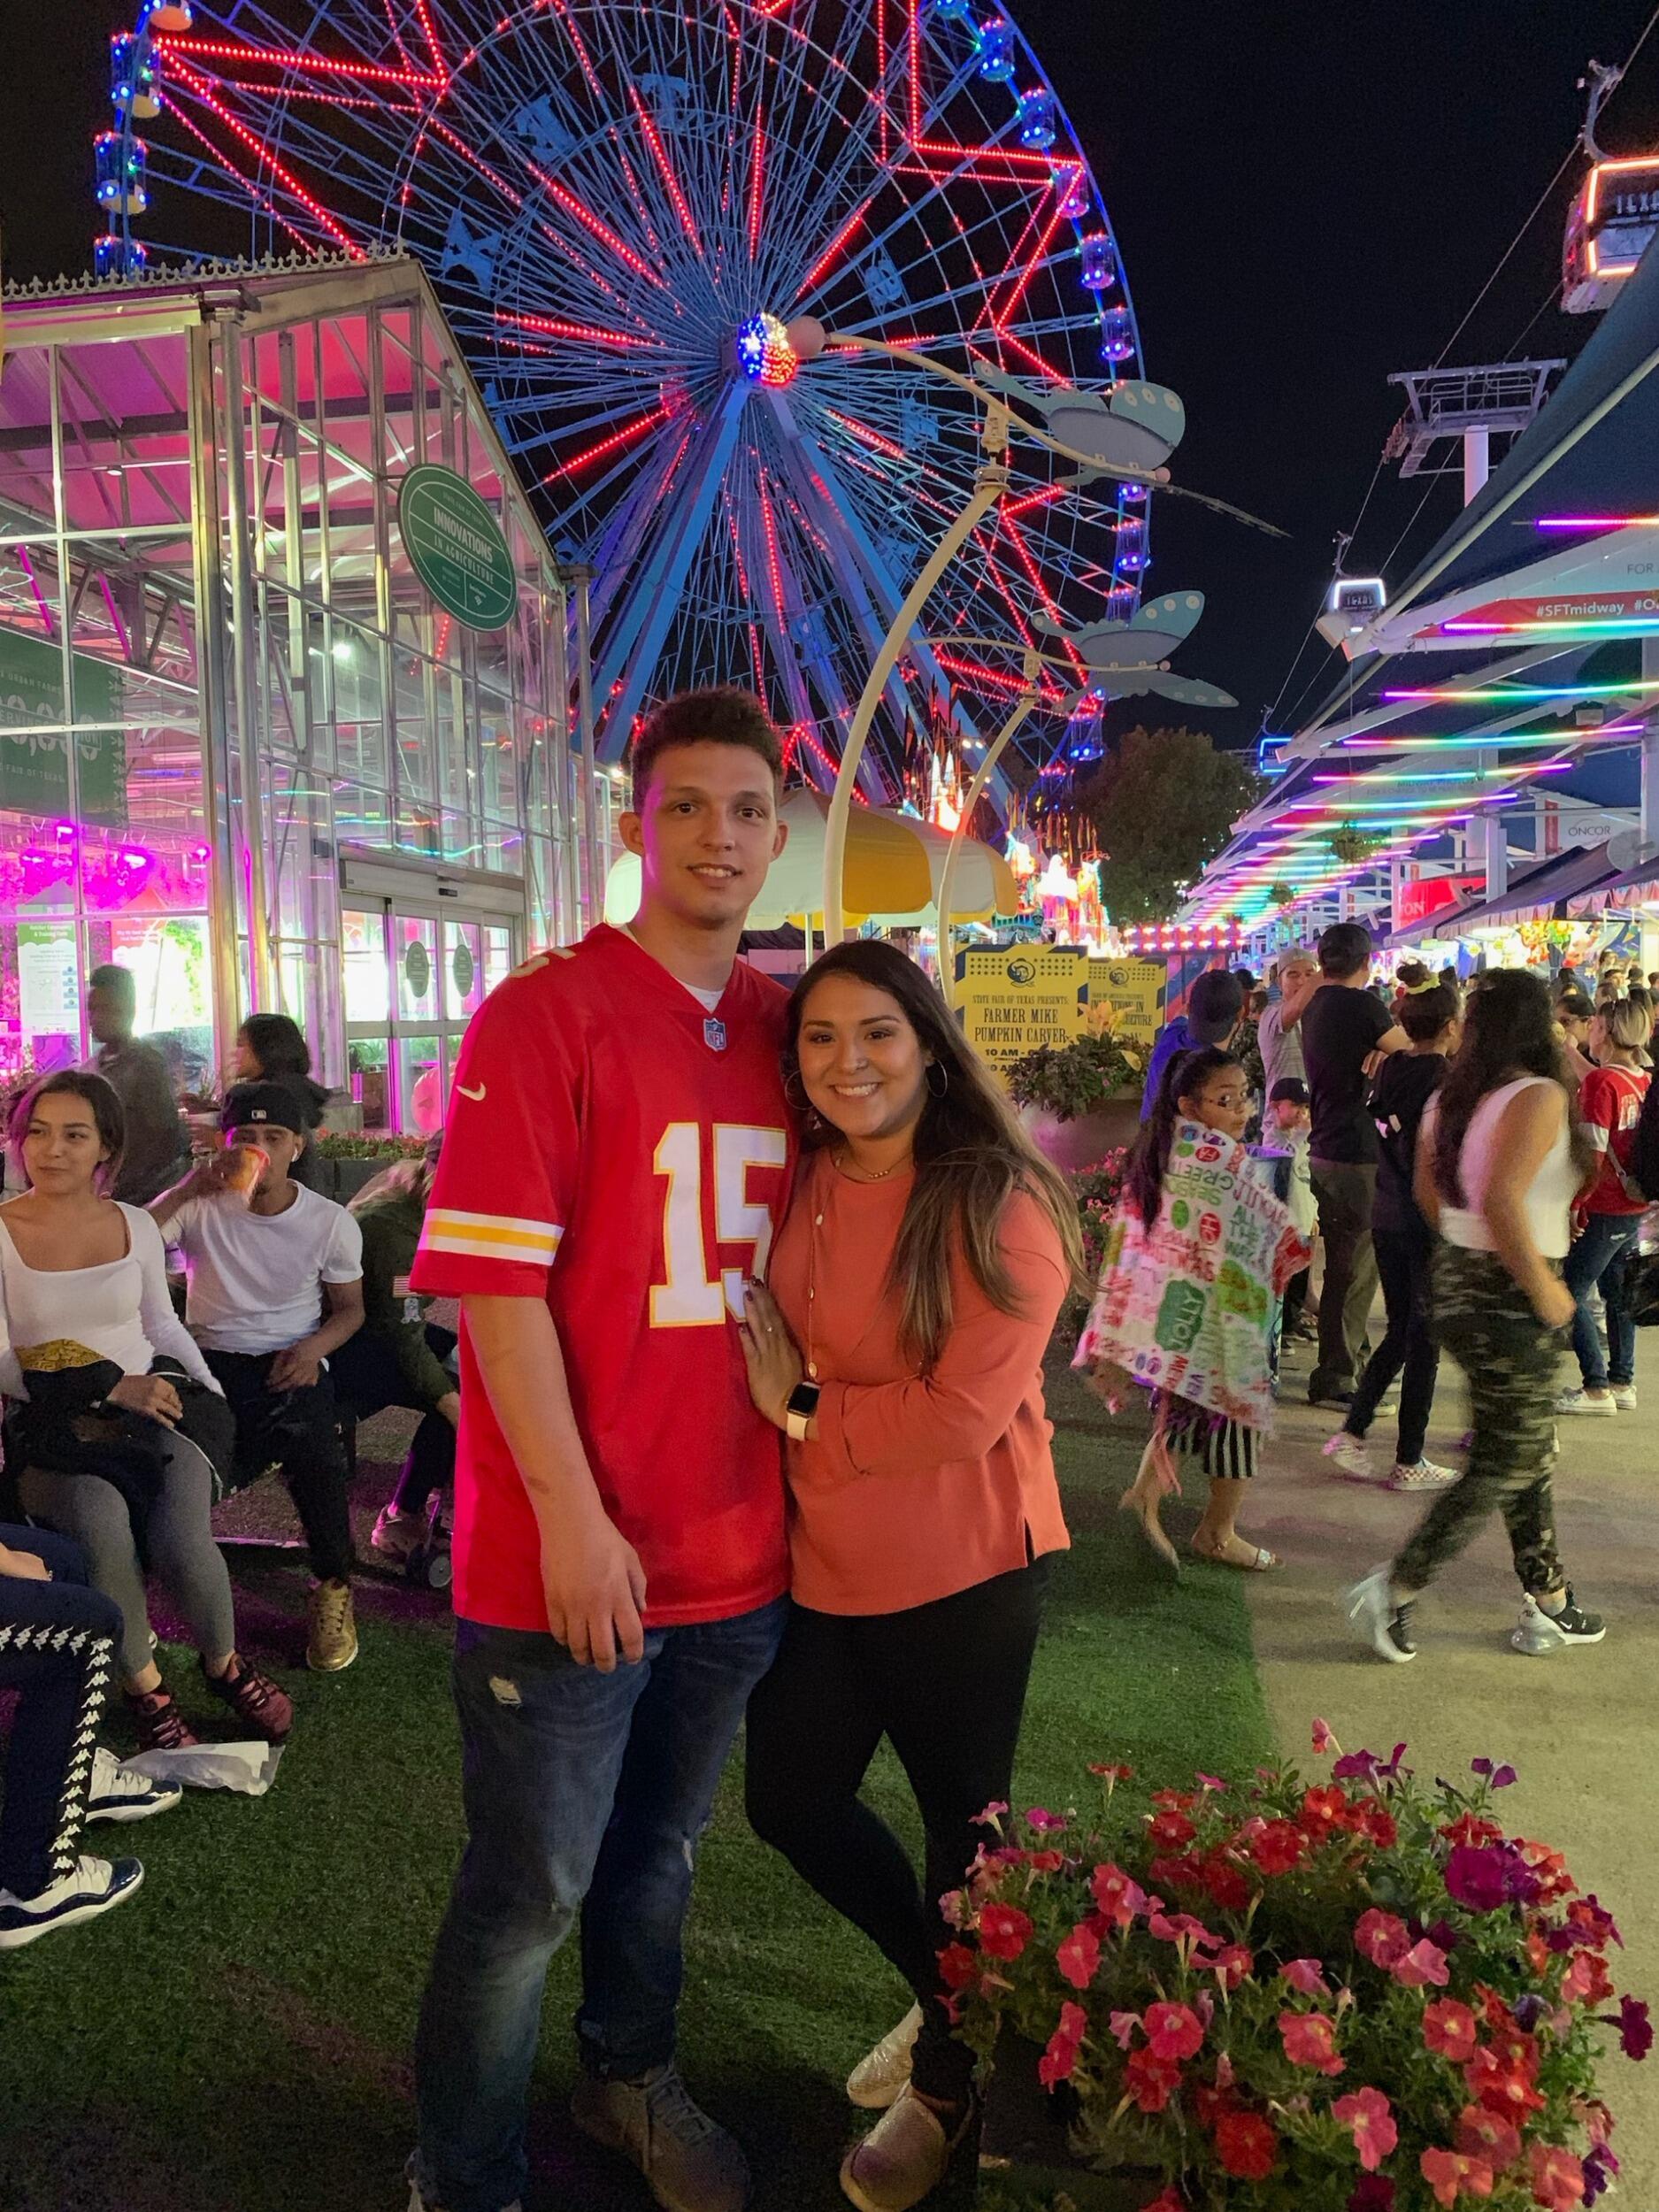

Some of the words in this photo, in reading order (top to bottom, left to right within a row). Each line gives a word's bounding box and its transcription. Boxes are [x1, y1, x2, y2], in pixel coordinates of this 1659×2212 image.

[434, 505, 493, 564] INNOVATIONS
[434, 534, 442, 549] IN
[445, 544, 494, 585] AGRICULTURE
[1627, 562, 1654, 575] FOR
[1536, 601, 1624, 618] #SFTmidway
[1634, 597, 1659, 612] #O
[1568, 825, 1611, 837] ONCOR
[1017, 995, 1034, 1004] TEXAS
[984, 1008, 1025, 1024] FARMER
[1031, 1008, 1059, 1024] MIKE
[974, 1027, 1022, 1042] PUMPKIN
[1026, 1027, 1067, 1044] CARVER
[649, 1121, 787, 1329] 15
[1170, 1288, 1204, 1345] JOLLY
